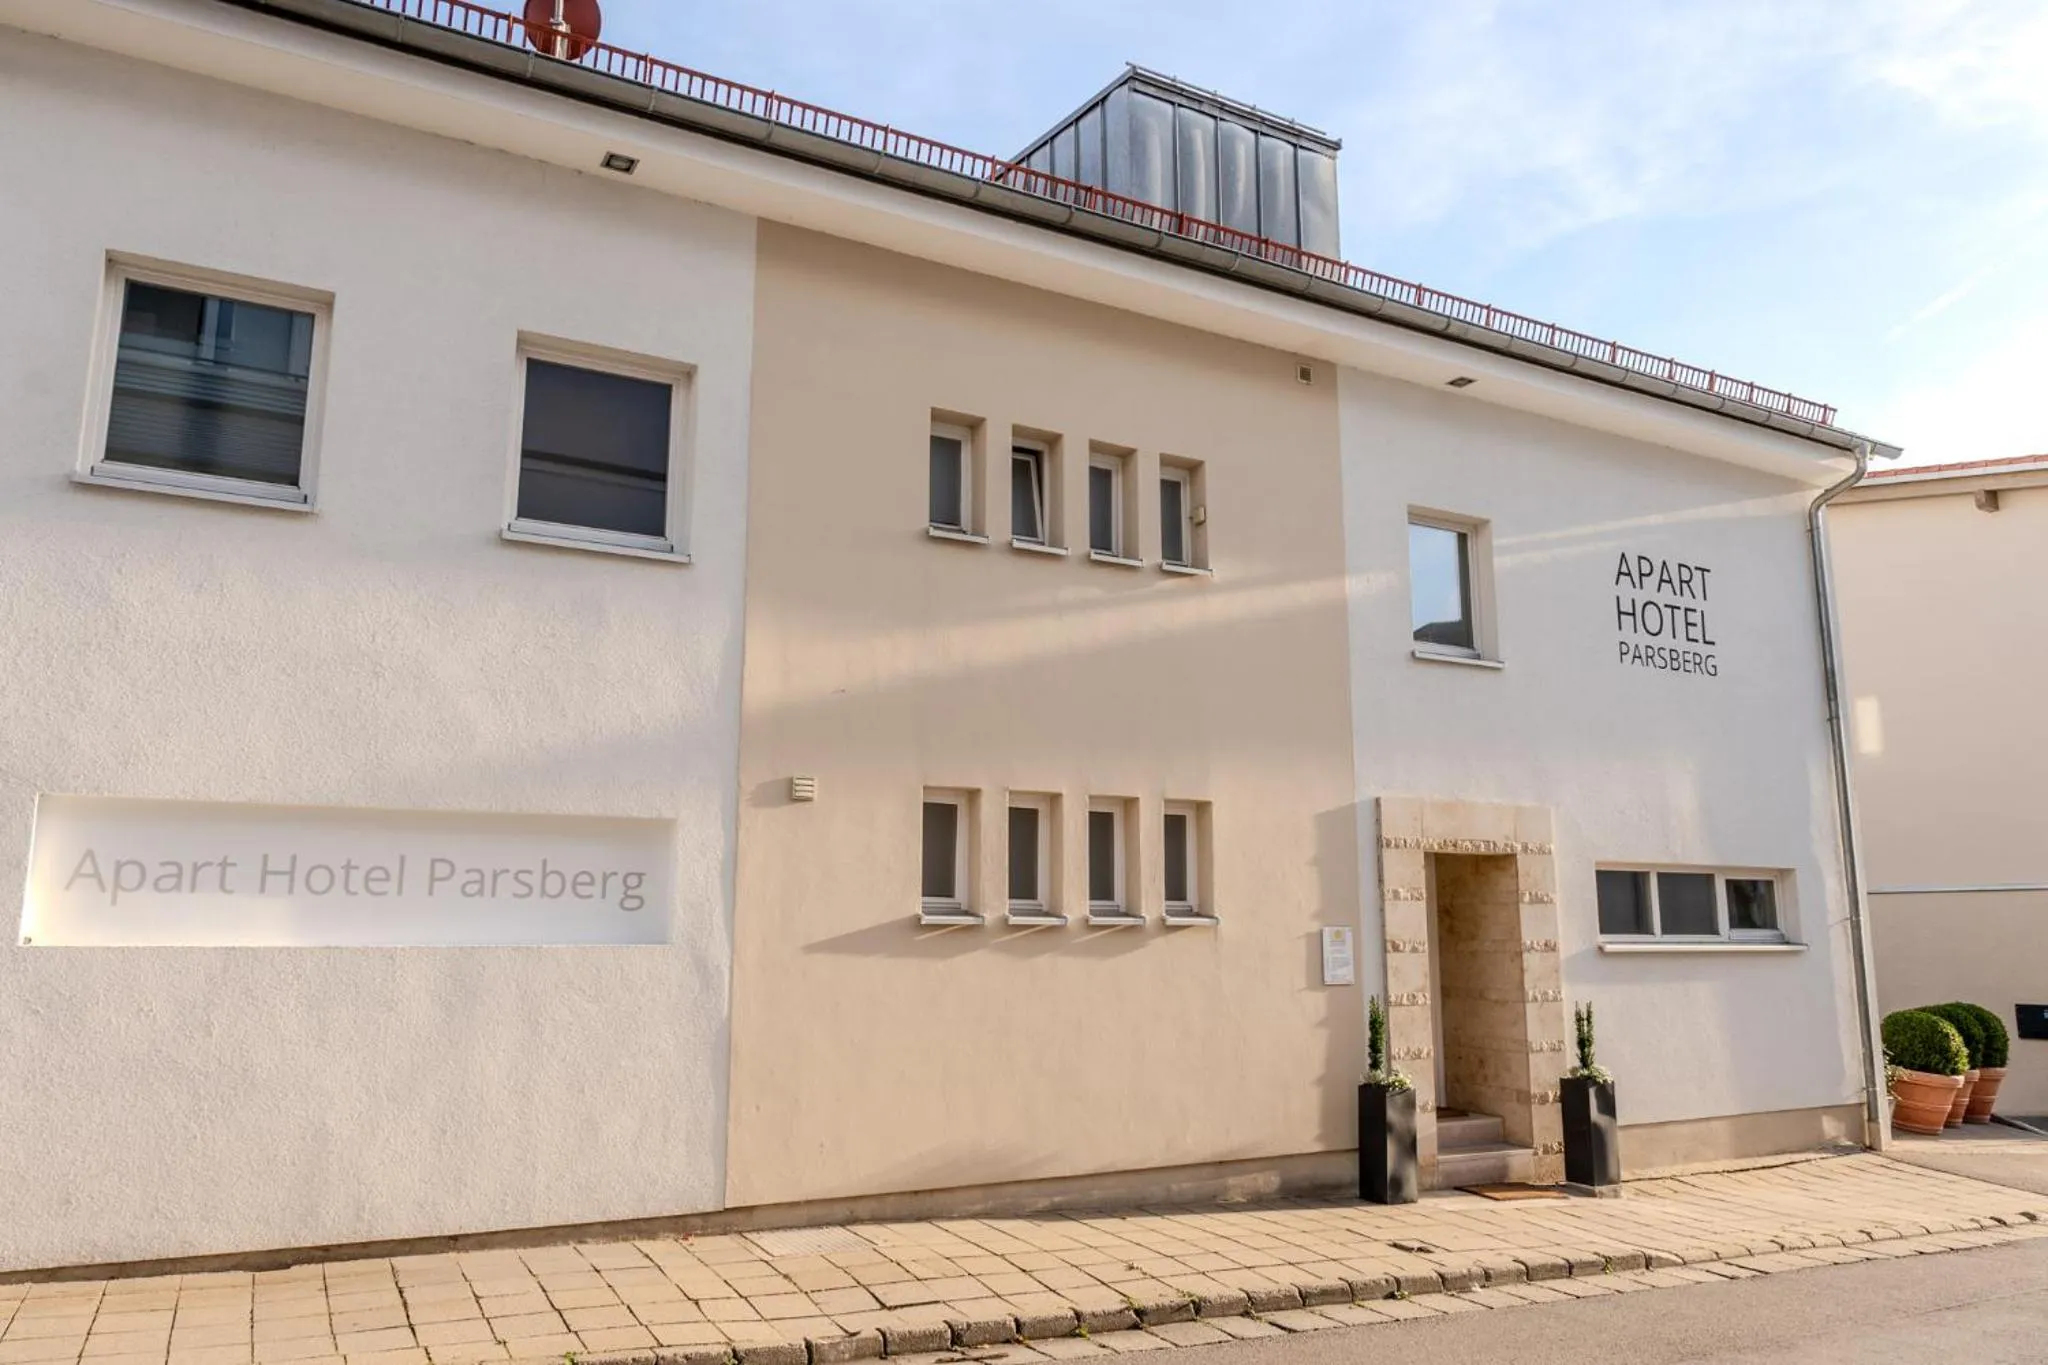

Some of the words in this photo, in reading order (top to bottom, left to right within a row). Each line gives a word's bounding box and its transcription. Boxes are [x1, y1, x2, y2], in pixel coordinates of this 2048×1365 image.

[1615, 552, 1711, 601] APART
[1616, 595, 1716, 646] HOTEL
[1618, 641, 1718, 677] PARSBERG
[64, 848, 238, 906] Apart
[259, 853, 406, 897] Hotel
[427, 857, 646, 911] Parsberg
